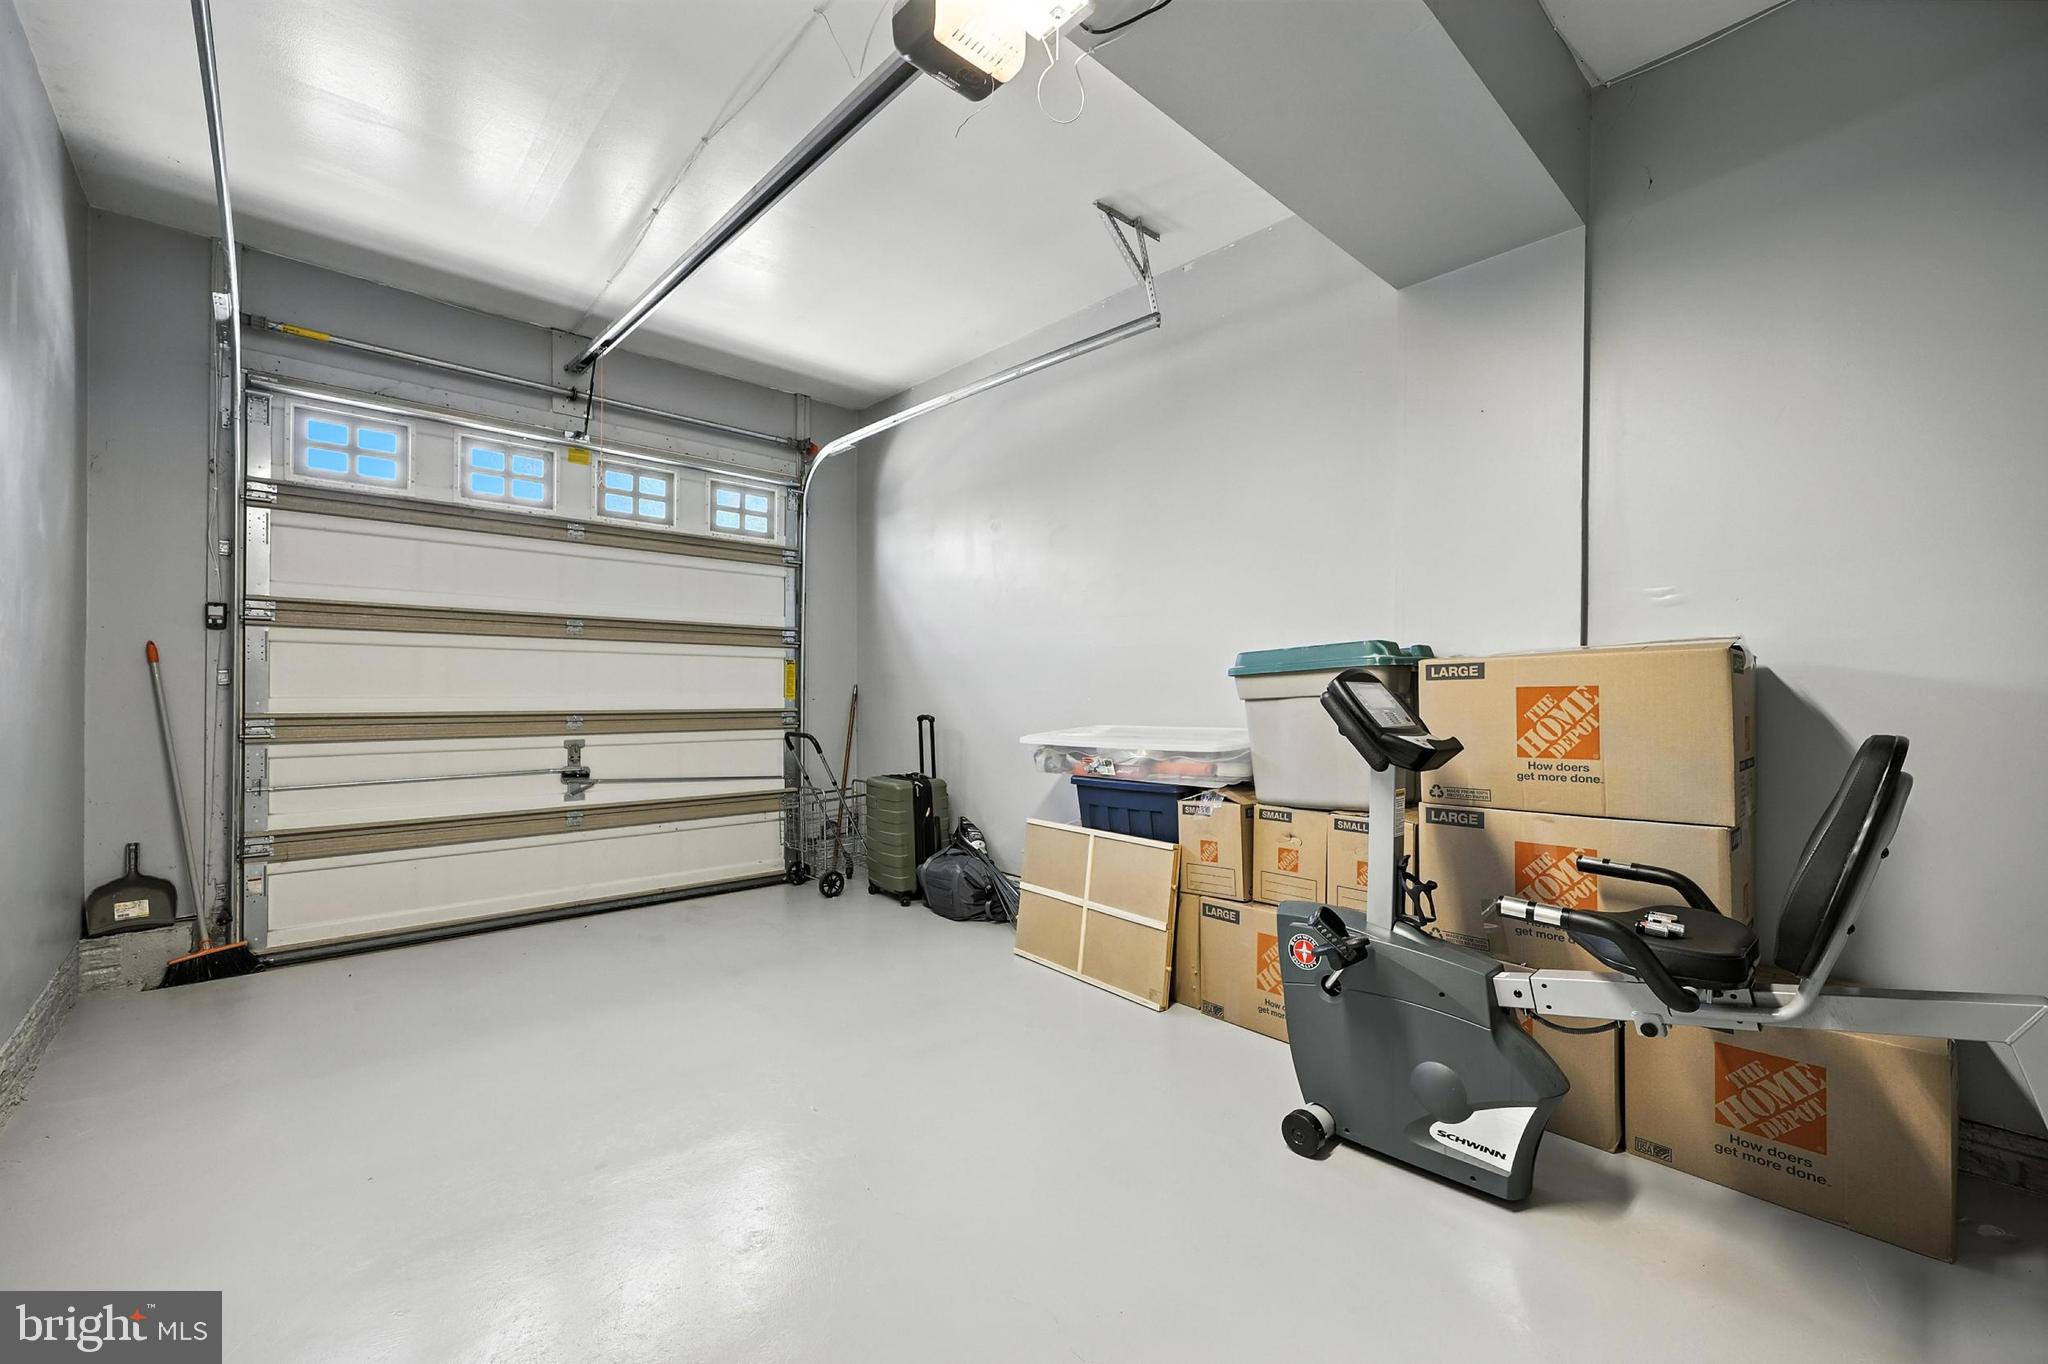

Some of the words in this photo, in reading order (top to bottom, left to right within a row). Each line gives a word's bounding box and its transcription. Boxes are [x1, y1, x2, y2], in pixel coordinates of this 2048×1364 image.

[1431, 665, 1479, 678] LARGE
[1523, 693, 1558, 723] THE
[1517, 686, 1600, 758] HOME
[1548, 712, 1600, 759] DEPOT
[1516, 772, 1535, 782] get
[1538, 775, 1568, 783] more
[1527, 761, 1553, 771] How
[1556, 763, 1590, 773] doers
[1262, 811, 1289, 821] SMALL
[1337, 820, 1369, 832] SMALL
[1431, 810, 1479, 825] LARGE
[1521, 851, 1556, 879] THE
[1205, 906, 1237, 921] LARGE
[1514, 927, 1533, 936] get
[1536, 929, 1565, 942] more
[1257, 1005, 1270, 1016] get
[1271, 1010, 1286, 1019] mor
[1265, 998, 1281, 1010] How
[1725, 1060, 1769, 1089] THE
[1715, 1062, 1826, 1130] HOME
[1757, 1097, 1826, 1140] DEPOT
[1436, 1129, 1507, 1160] SCHWINN
[1730, 1134, 1762, 1152] How
[1767, 1147, 1813, 1168] doers
[1714, 1143, 1738, 1157] get
[1742, 1152, 1782, 1170] more
